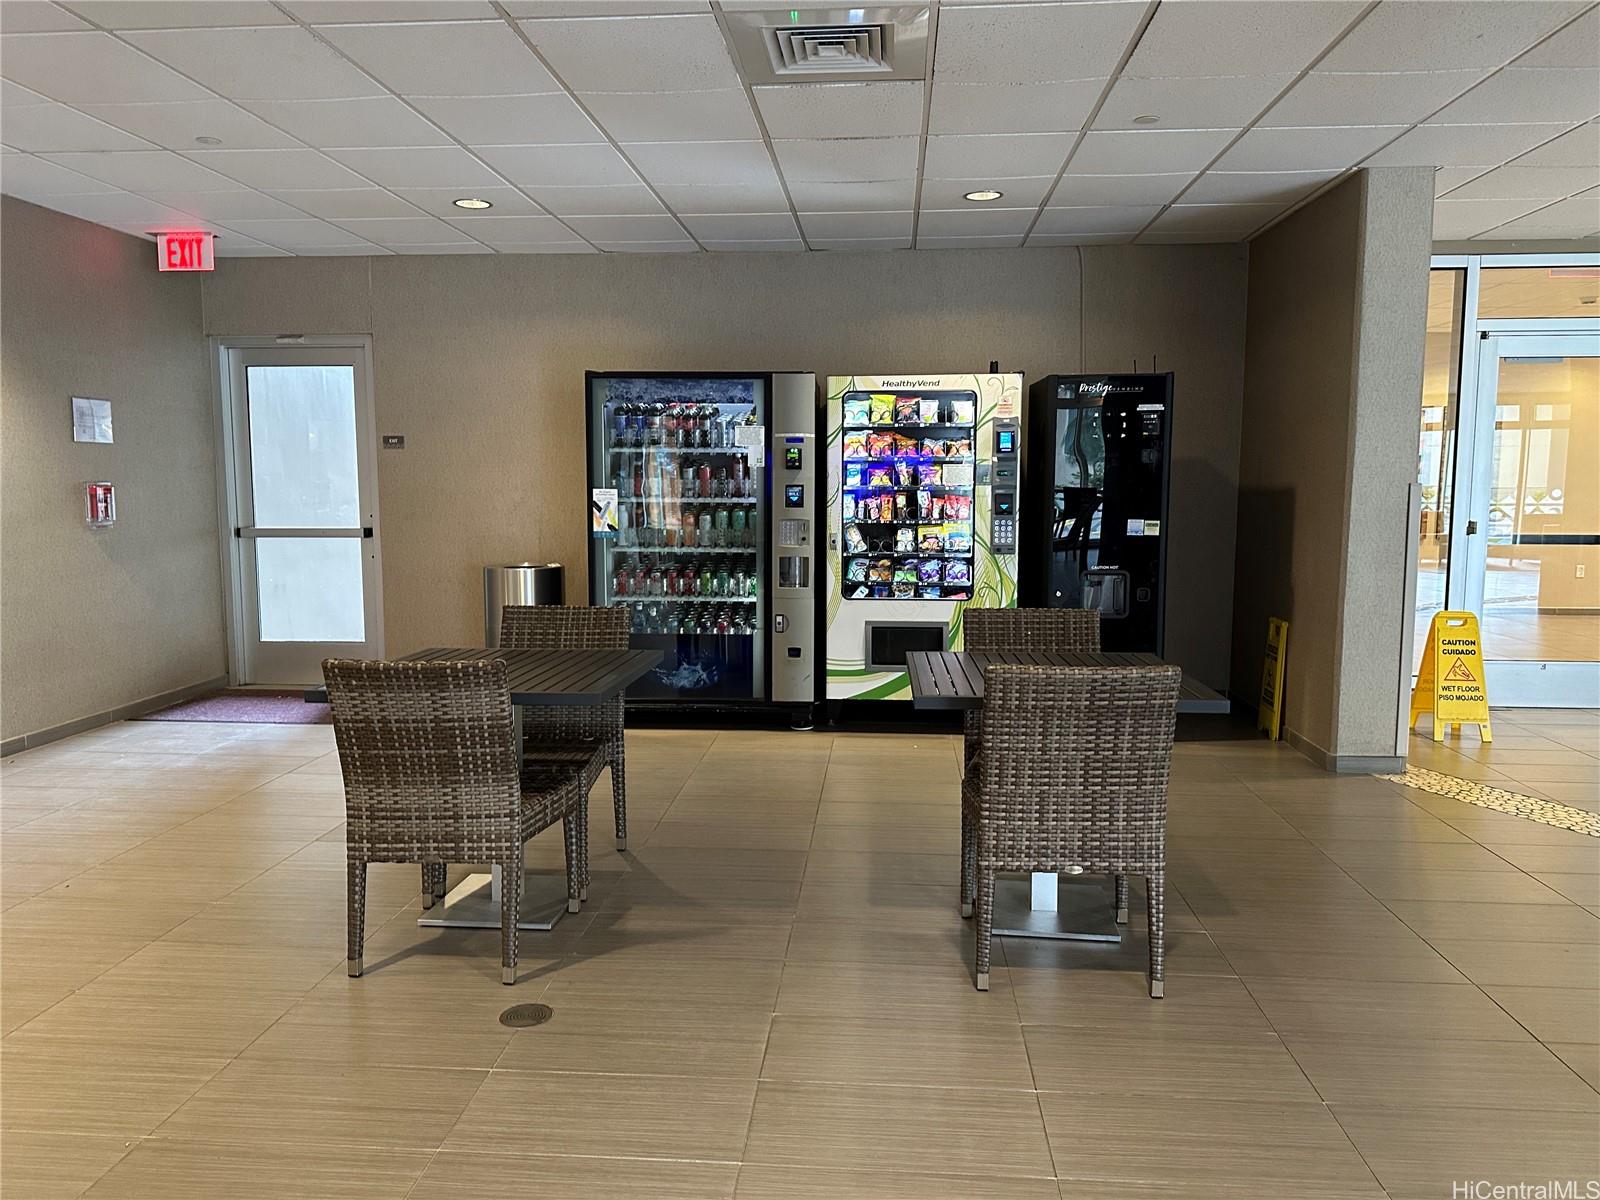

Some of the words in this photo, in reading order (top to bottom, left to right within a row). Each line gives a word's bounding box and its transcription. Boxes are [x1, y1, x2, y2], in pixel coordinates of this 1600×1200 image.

[166, 237, 203, 268] EXIT
[882, 379, 940, 389] HealthyVend
[1079, 382, 1113, 397] Prestige
[1441, 685, 1456, 693] WET
[1456, 685, 1480, 693] FLOOR
